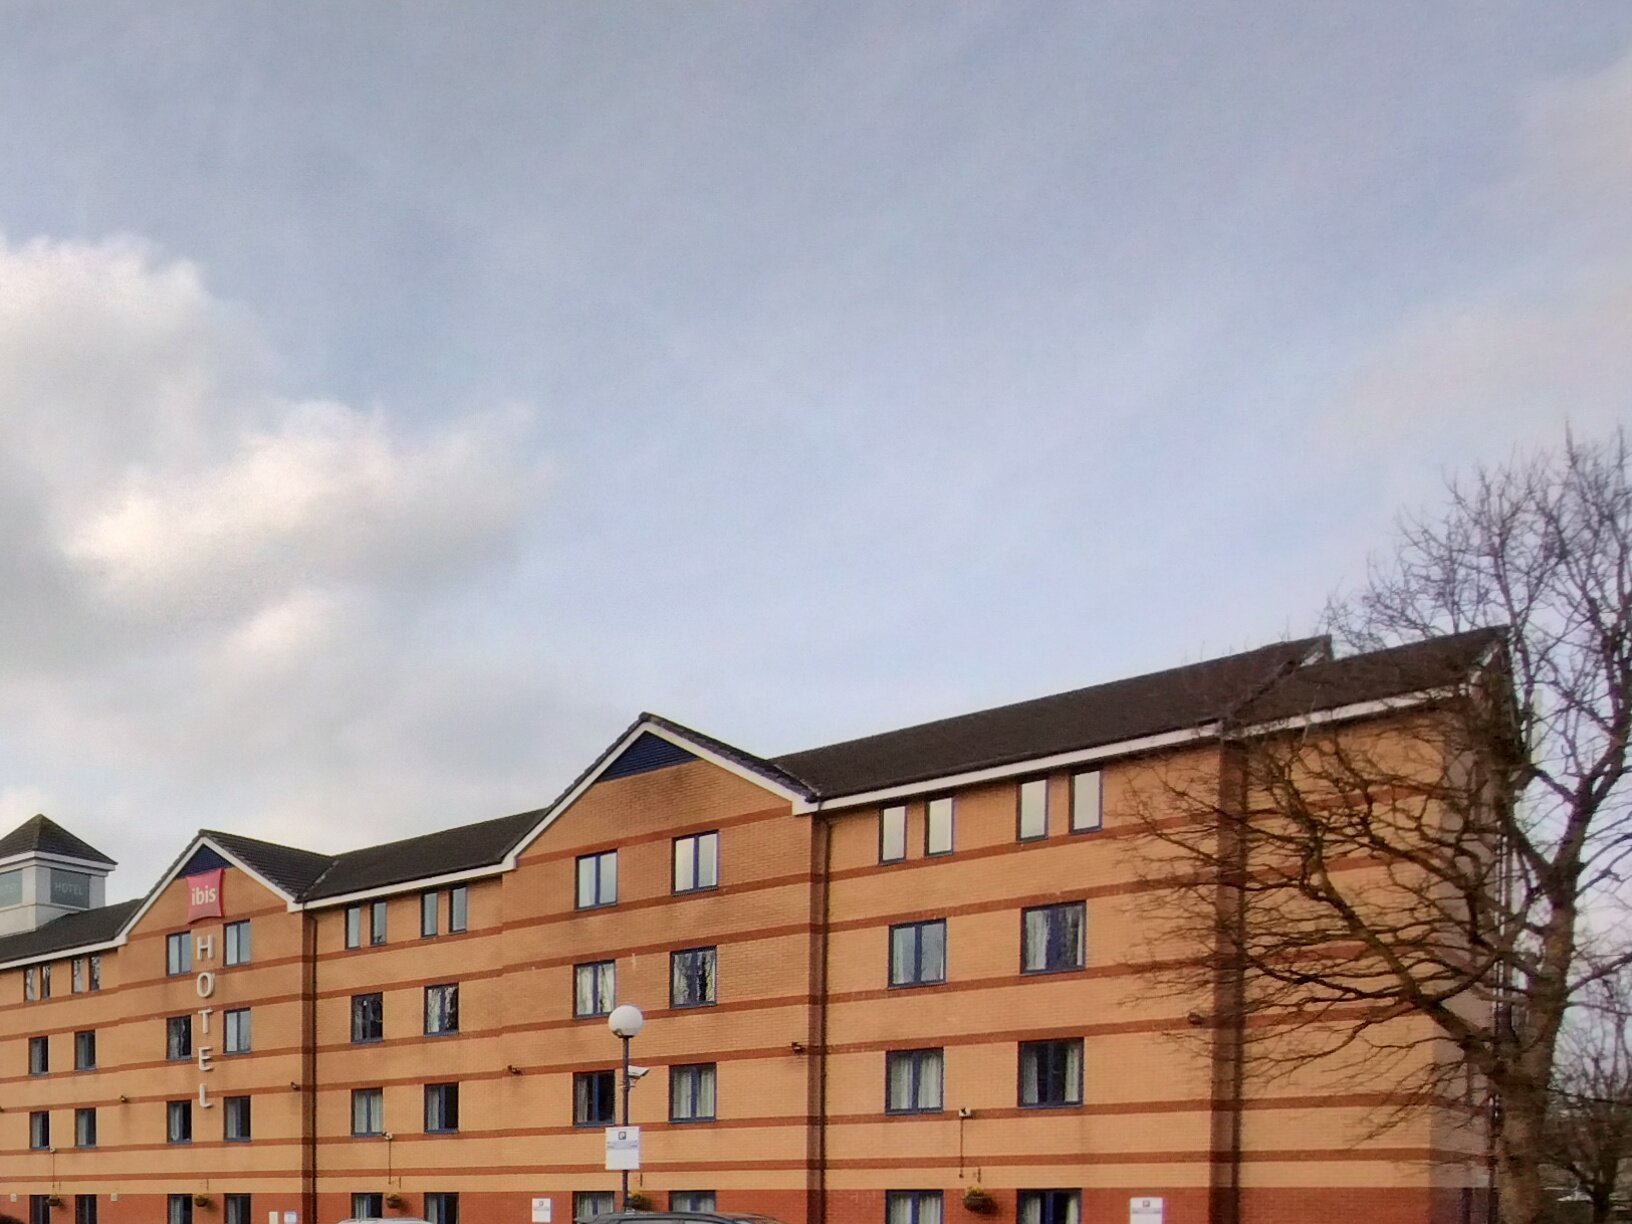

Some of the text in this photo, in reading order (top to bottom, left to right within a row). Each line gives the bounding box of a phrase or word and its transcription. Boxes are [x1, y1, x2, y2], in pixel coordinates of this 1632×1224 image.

[54, 881, 84, 896] HOTEL
[191, 885, 216, 906] ibis
[196, 934, 214, 1109] HOTEL
